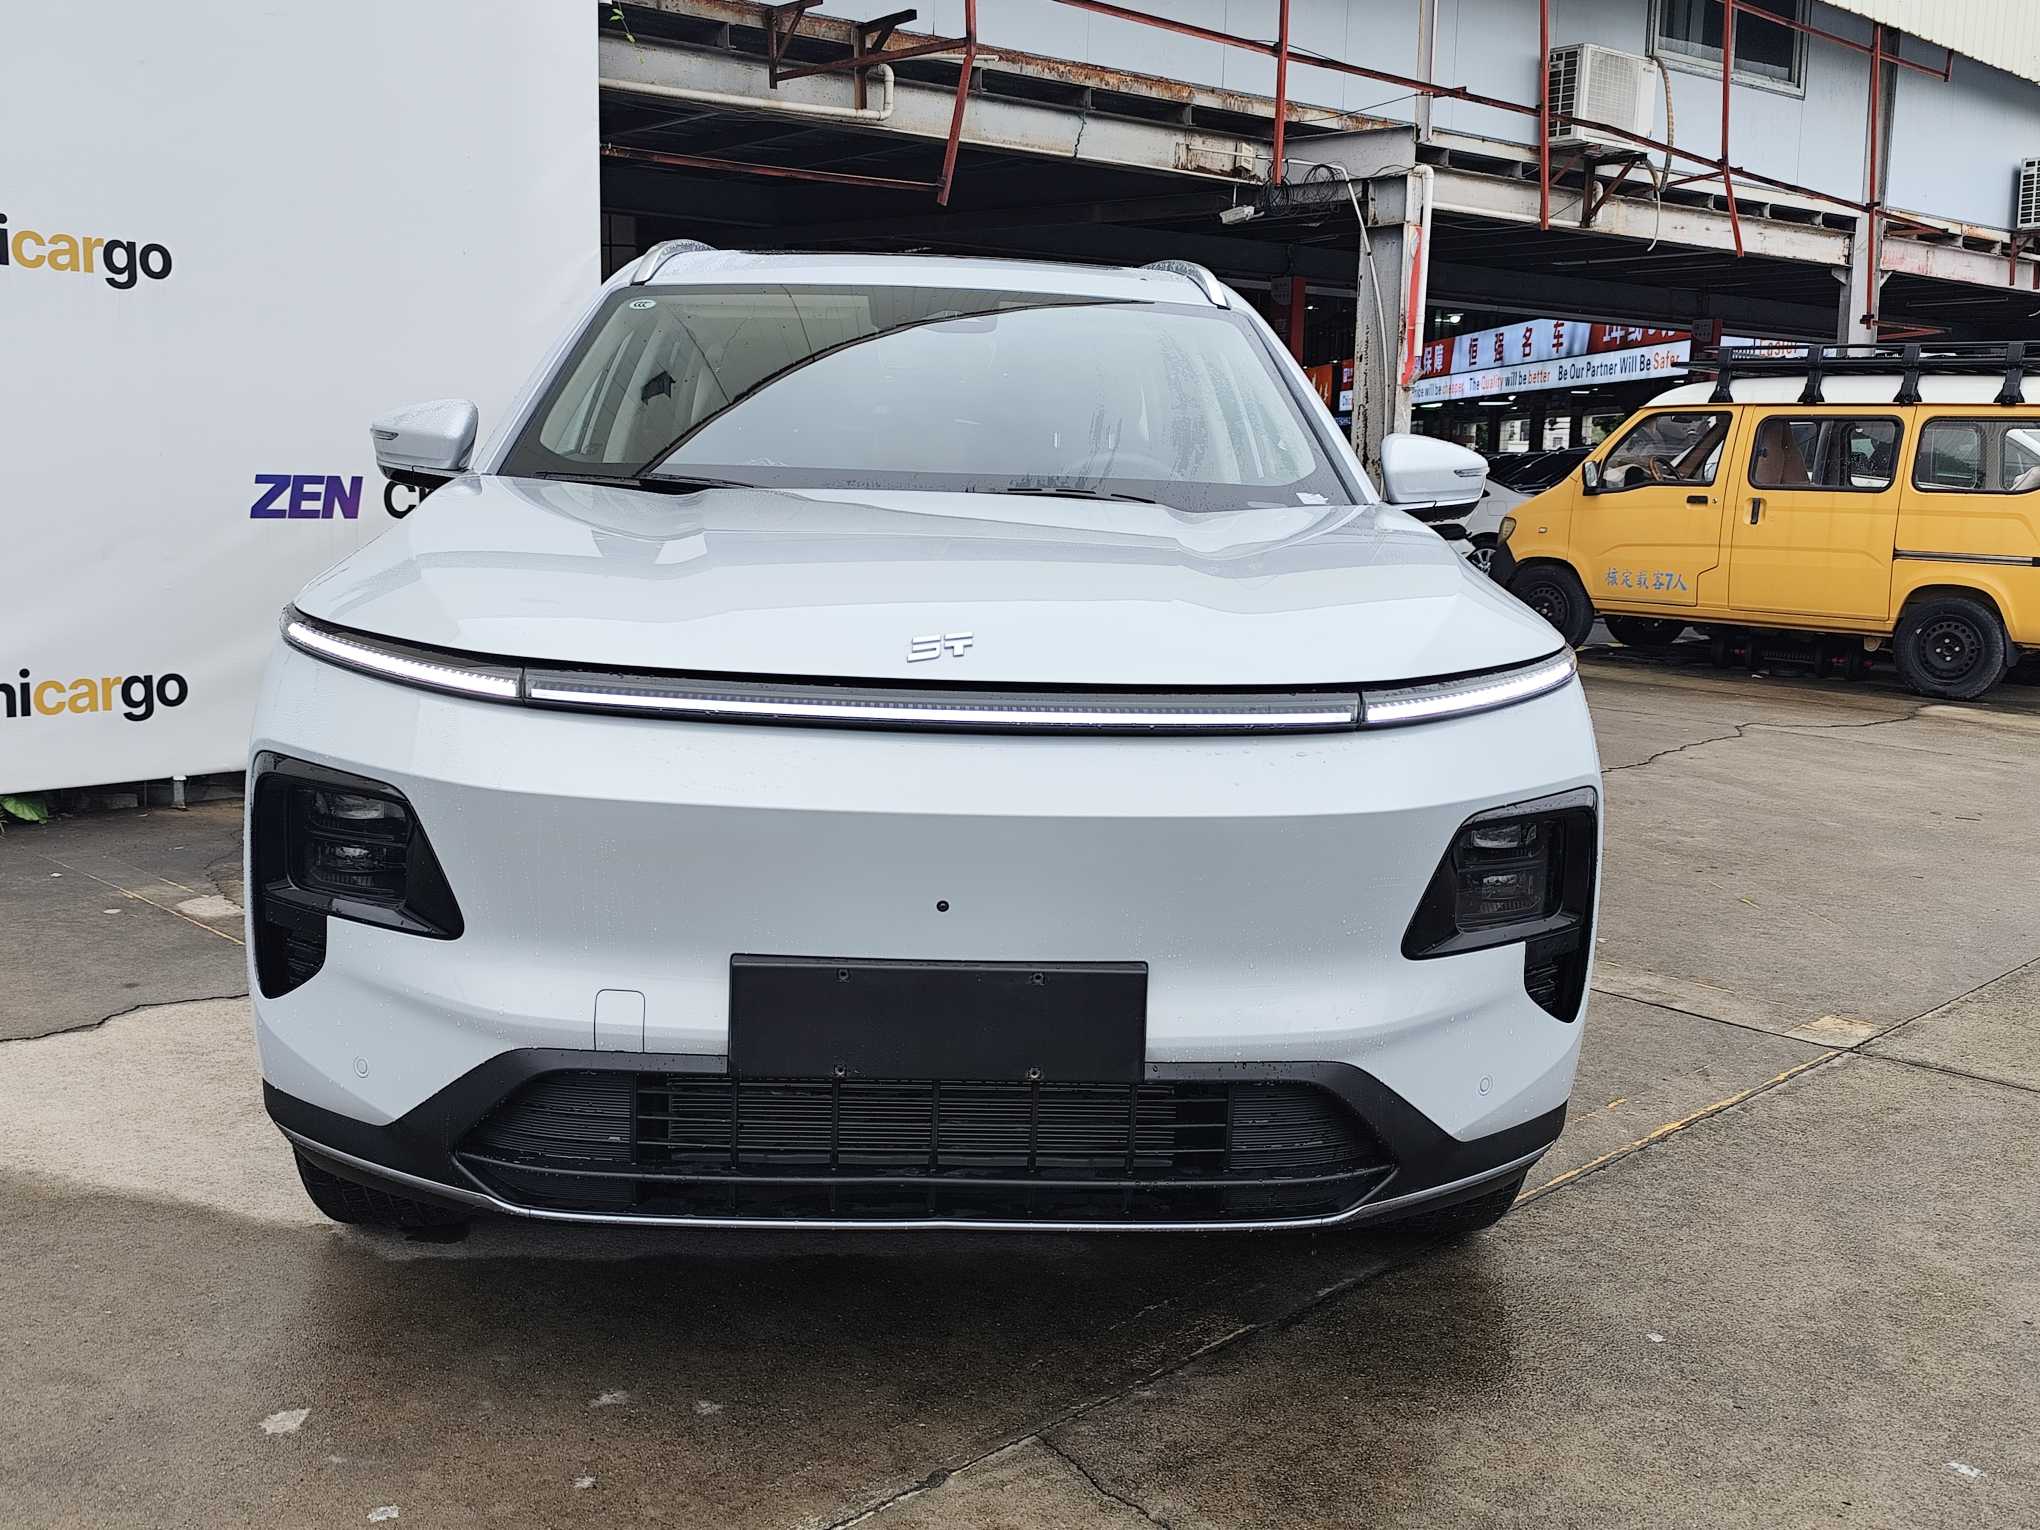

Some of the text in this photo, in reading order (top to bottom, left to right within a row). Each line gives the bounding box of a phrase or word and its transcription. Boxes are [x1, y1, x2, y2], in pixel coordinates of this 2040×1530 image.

[1469, 320, 1565, 367] 恒强名车
[1505, 372, 1517, 387] will
[1518, 370, 1527, 385] be
[1528, 368, 1551, 385] better
[1558, 365, 1568, 381] Be
[1569, 363, 1584, 380] Our
[1586, 361, 1617, 378] Partner
[1620, 355, 1637, 374] Will
[1640, 354, 1651, 372] Be
[1653, 350, 1680, 370] Safer
[250, 474, 363, 519] ZEN
